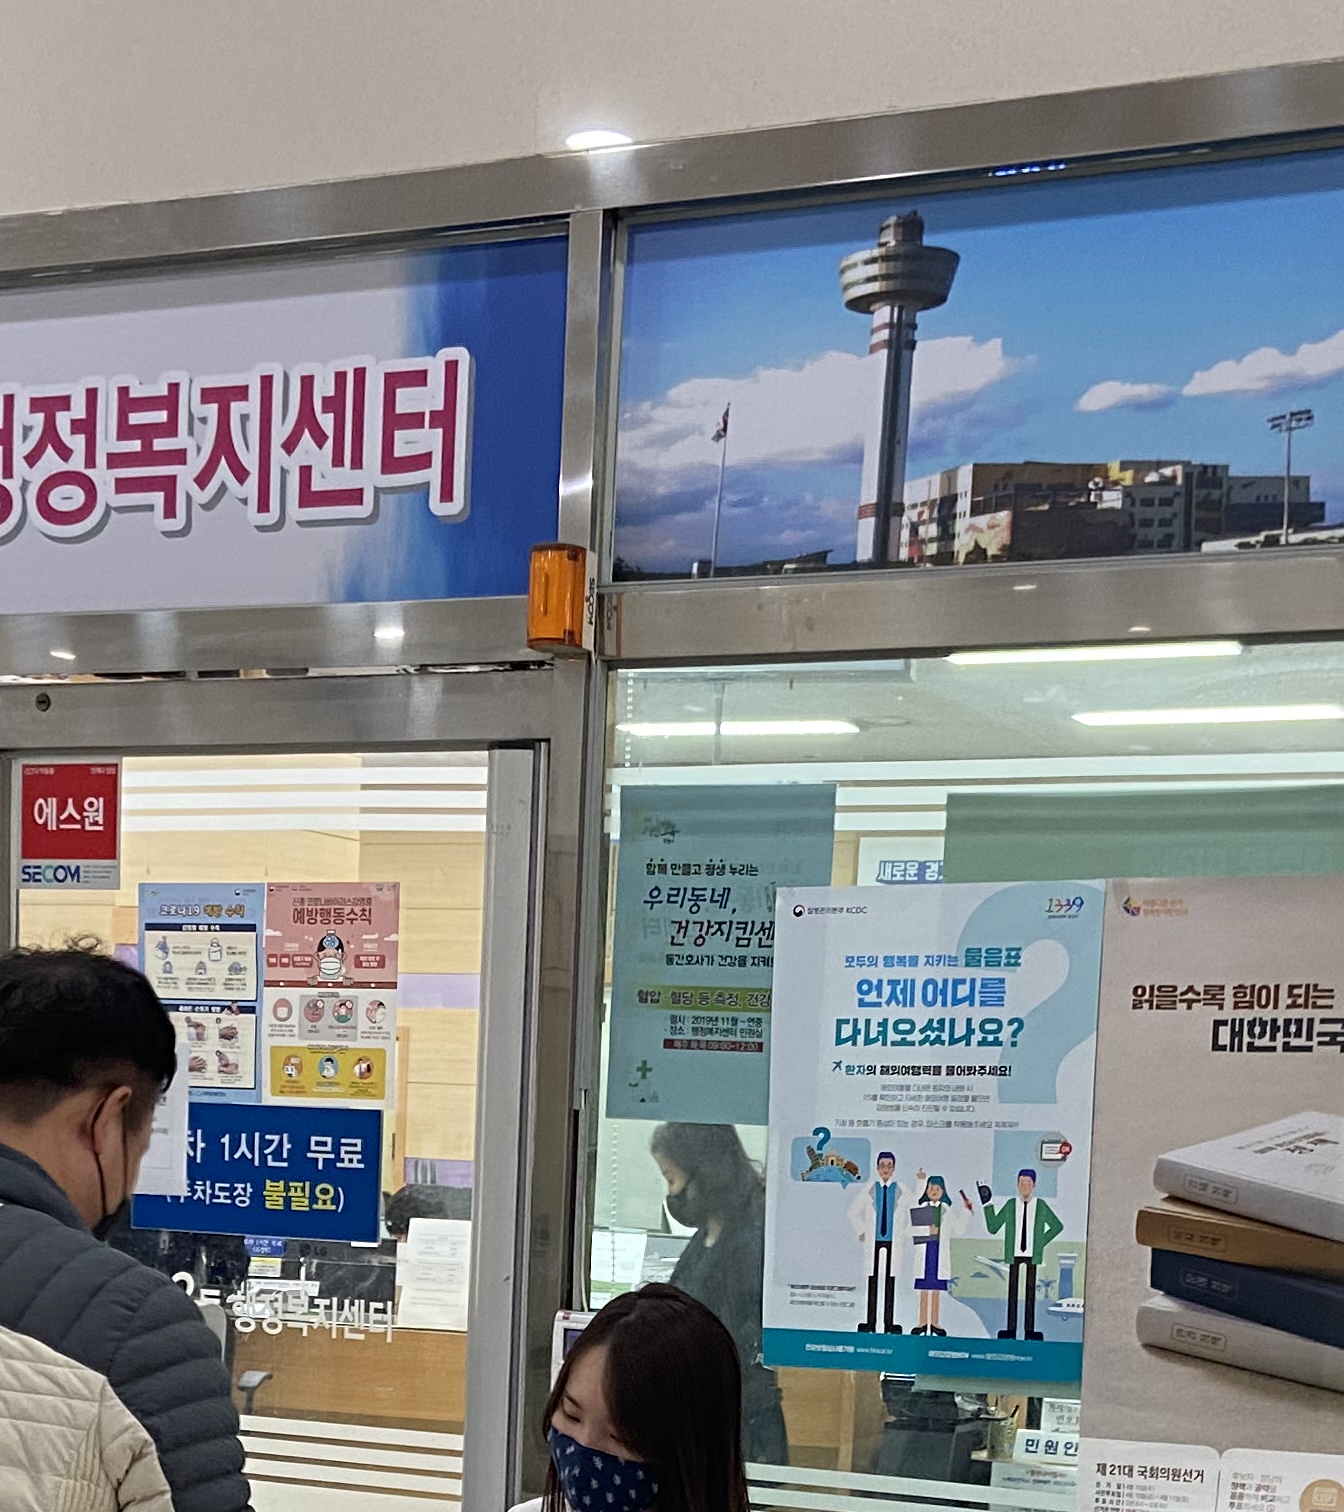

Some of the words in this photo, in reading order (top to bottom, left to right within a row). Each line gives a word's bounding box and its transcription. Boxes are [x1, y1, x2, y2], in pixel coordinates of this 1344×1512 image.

[33, 797, 104, 831] 에스원
[21, 865, 80, 883] SECOM
[729, 863, 759, 877] 누리는
[877, 861, 918, 881] 새로운
[643, 886, 737, 915] 우리동네,
[1045, 896, 1084, 913] 1339
[160, 904, 201, 917] 코로나19
[225, 904, 245, 918] 수칙
[292, 907, 372, 925] 예방행동수칙
[844, 955, 879, 968] 모두의
[924, 954, 959, 968] 지키는
[964, 947, 1022, 968] 물음표
[697, 992, 711, 1006] 등
[856, 978, 916, 1008] 언제
[922, 977, 1006, 1008] 어디를
[1131, 984, 1225, 1011] 읽을수록
[1231, 983, 1280, 1010] 힘이
[1286, 984, 1335, 1011] 되는
[835, 1017, 1025, 1048] 다녀오셨나요?
[220, 1132, 292, 1167] 1시간
[306, 1135, 365, 1170] 무료
[166, 1179, 253, 1208] 차도장
[262, 1179, 345, 1213] 불필요)
[1109, 1464, 1133, 1478] 21대
[1137, 1465, 1205, 1484] 국회의원선거
